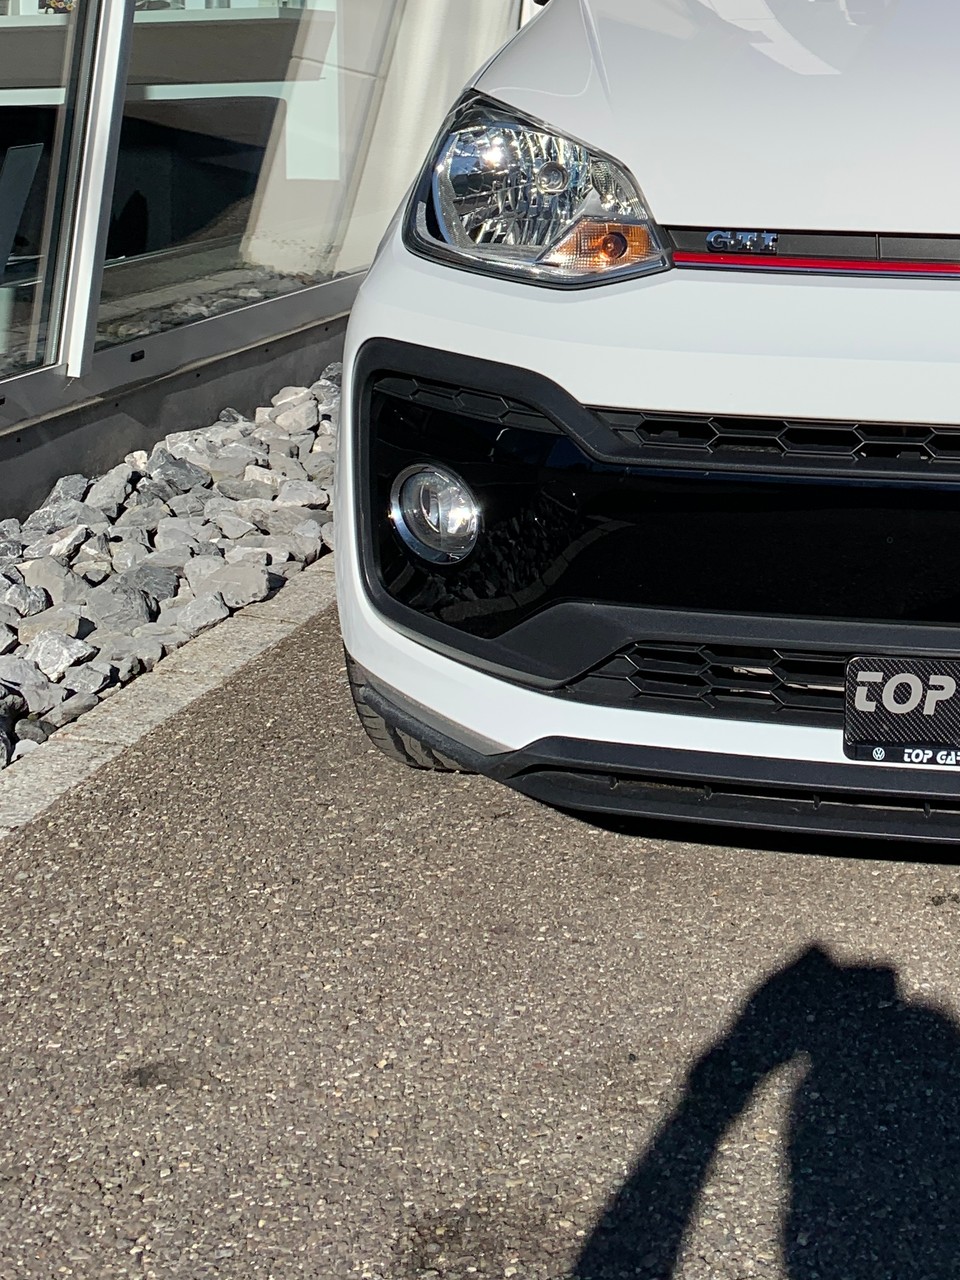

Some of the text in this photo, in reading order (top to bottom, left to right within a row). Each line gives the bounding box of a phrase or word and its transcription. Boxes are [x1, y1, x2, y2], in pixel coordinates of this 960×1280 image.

[706, 230, 778, 255] GTI
[854, 671, 957, 716] TOP
[903, 748, 932, 764] TOP
